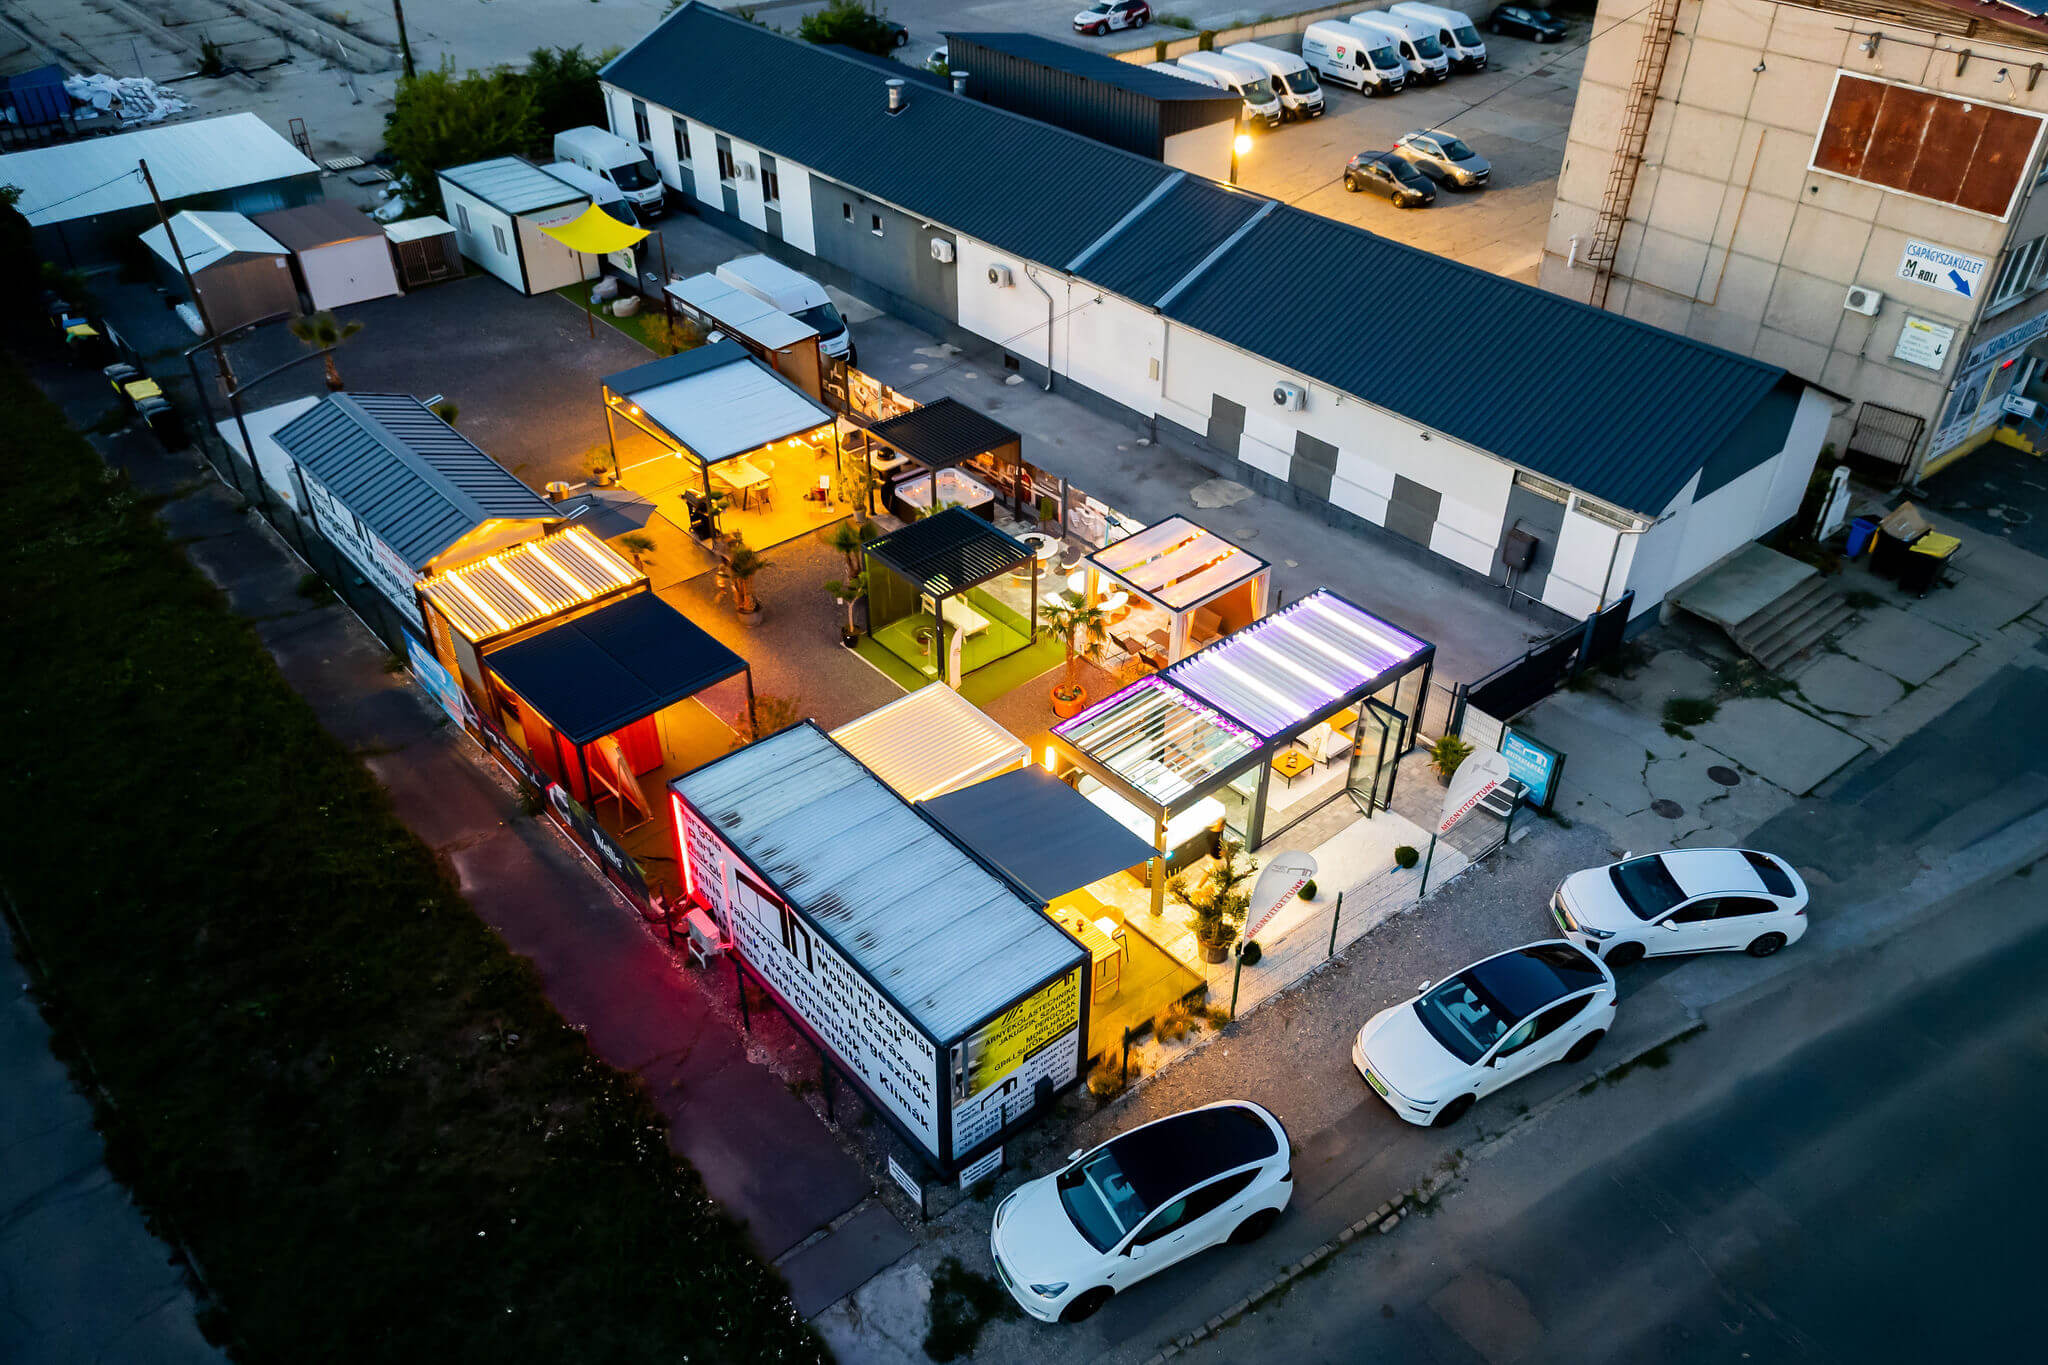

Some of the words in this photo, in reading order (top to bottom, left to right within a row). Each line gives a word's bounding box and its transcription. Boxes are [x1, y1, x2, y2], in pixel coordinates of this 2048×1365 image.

[1441, 780, 1497, 831] MEGNYITOTTUNK
[1246, 879, 1305, 939] MEGNYITOTTUNK
[763, 963, 791, 997] Autó
[785, 956, 844, 1023] Szaunák,
[817, 955, 854, 999] Mobil
[858, 995, 902, 1046] Házak
[822, 975, 858, 1019] Mobil
[863, 1017, 931, 1092] Garázsok
[878, 998, 934, 1062] Pergolák
[879, 1071, 931, 1132] Klímák
